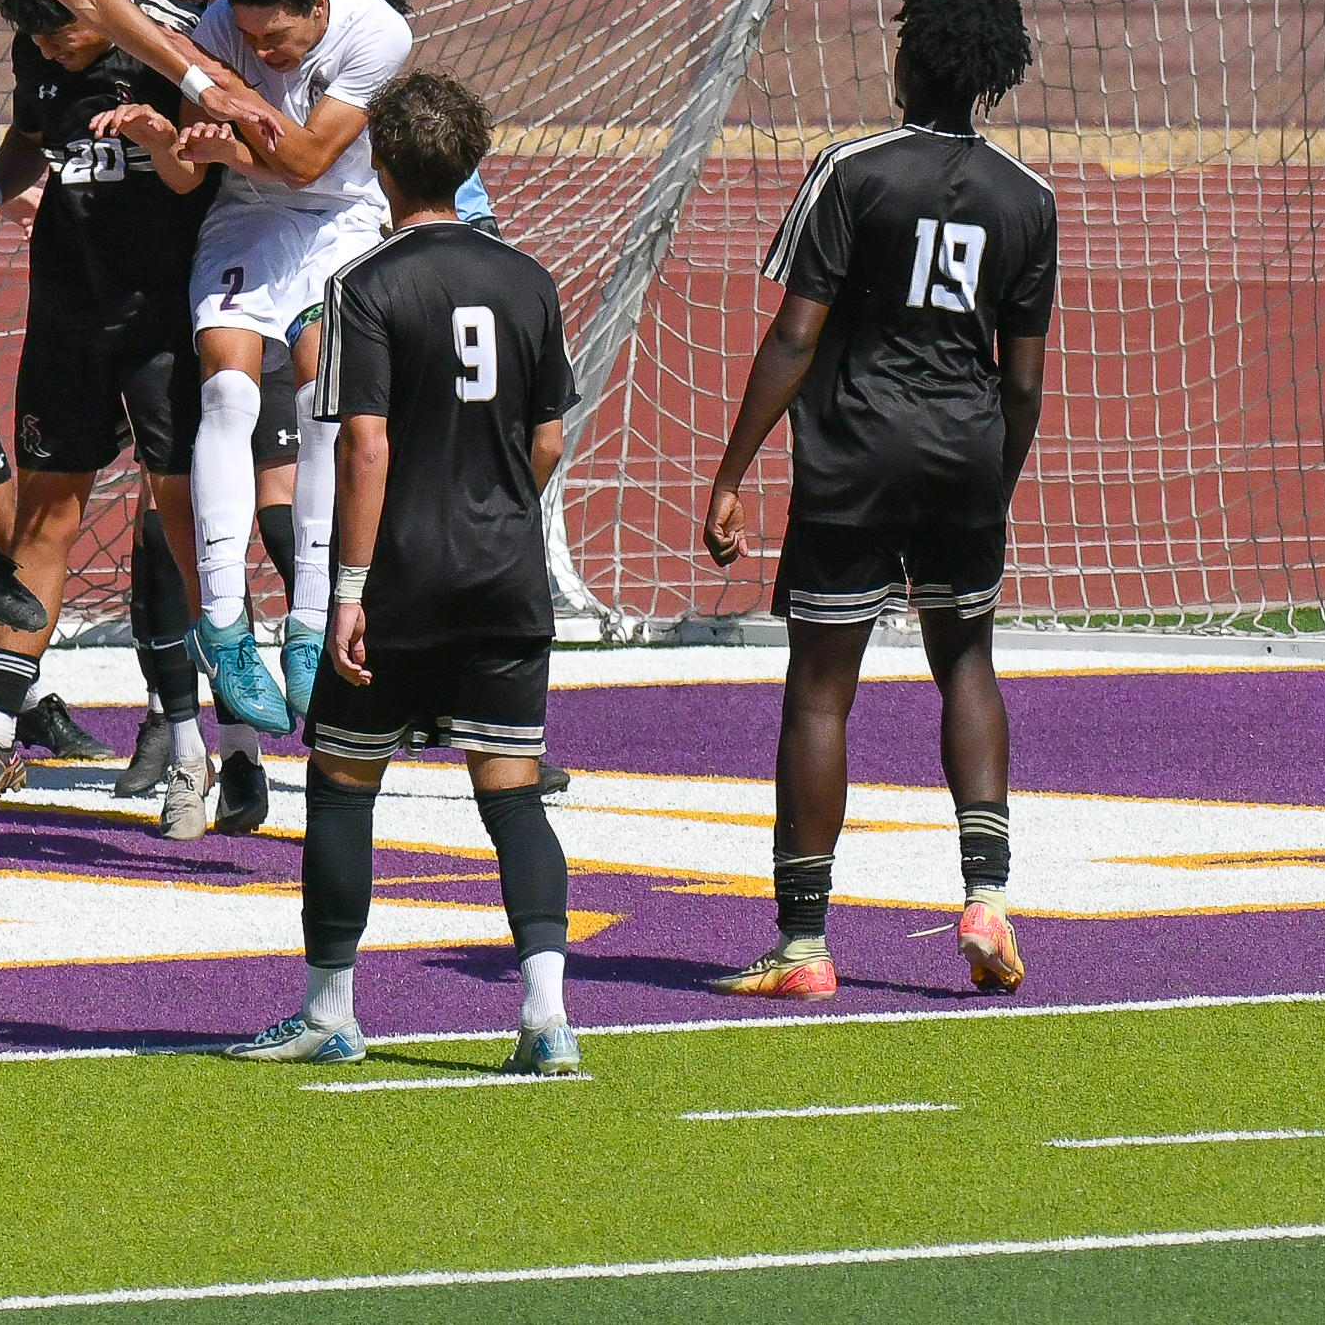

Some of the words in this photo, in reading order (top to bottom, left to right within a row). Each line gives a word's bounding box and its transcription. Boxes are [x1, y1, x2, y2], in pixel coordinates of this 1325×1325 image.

[61, 138, 126, 185] 20
[219, 266, 244, 312] 2
[906, 218, 987, 313] 19
[452, 306, 497, 403] 9
